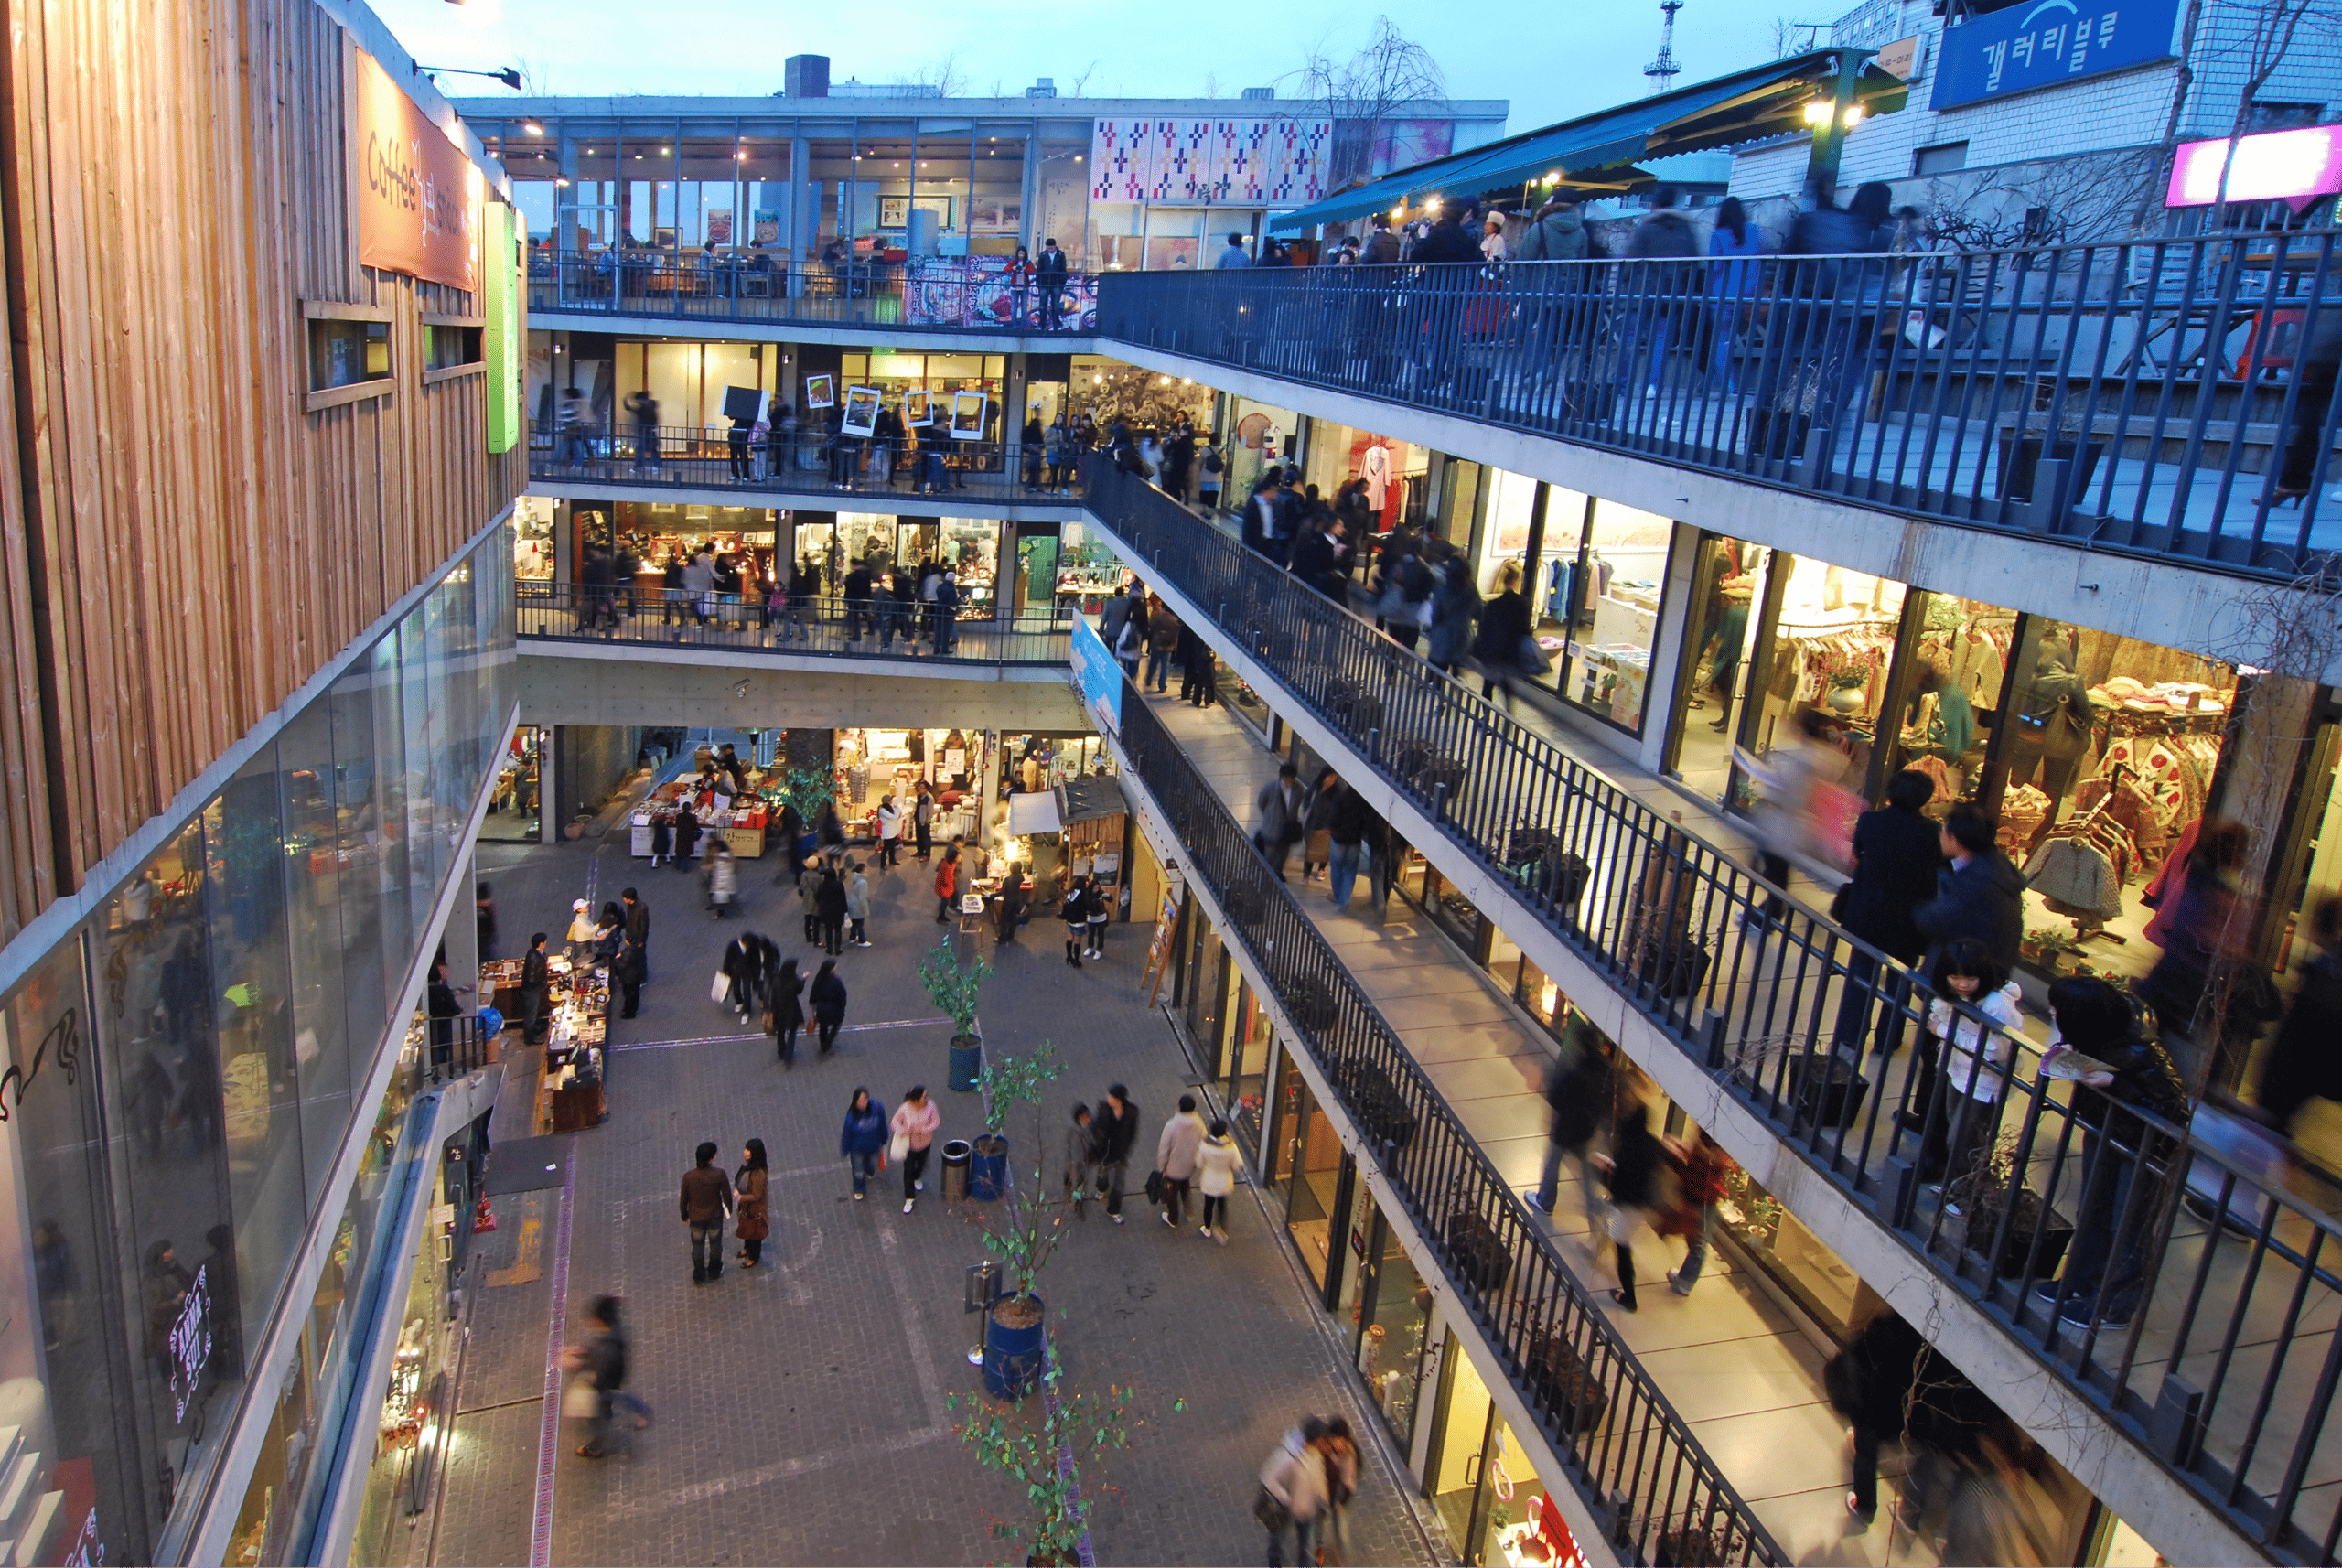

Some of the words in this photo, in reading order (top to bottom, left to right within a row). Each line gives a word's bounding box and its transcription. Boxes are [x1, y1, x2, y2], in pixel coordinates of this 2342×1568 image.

[1982, 11, 2118, 92] 갤러리블루
[368, 130, 416, 212] Coffee
[178, 1291, 202, 1362] ANNA
[186, 1330, 201, 1383] SUI
